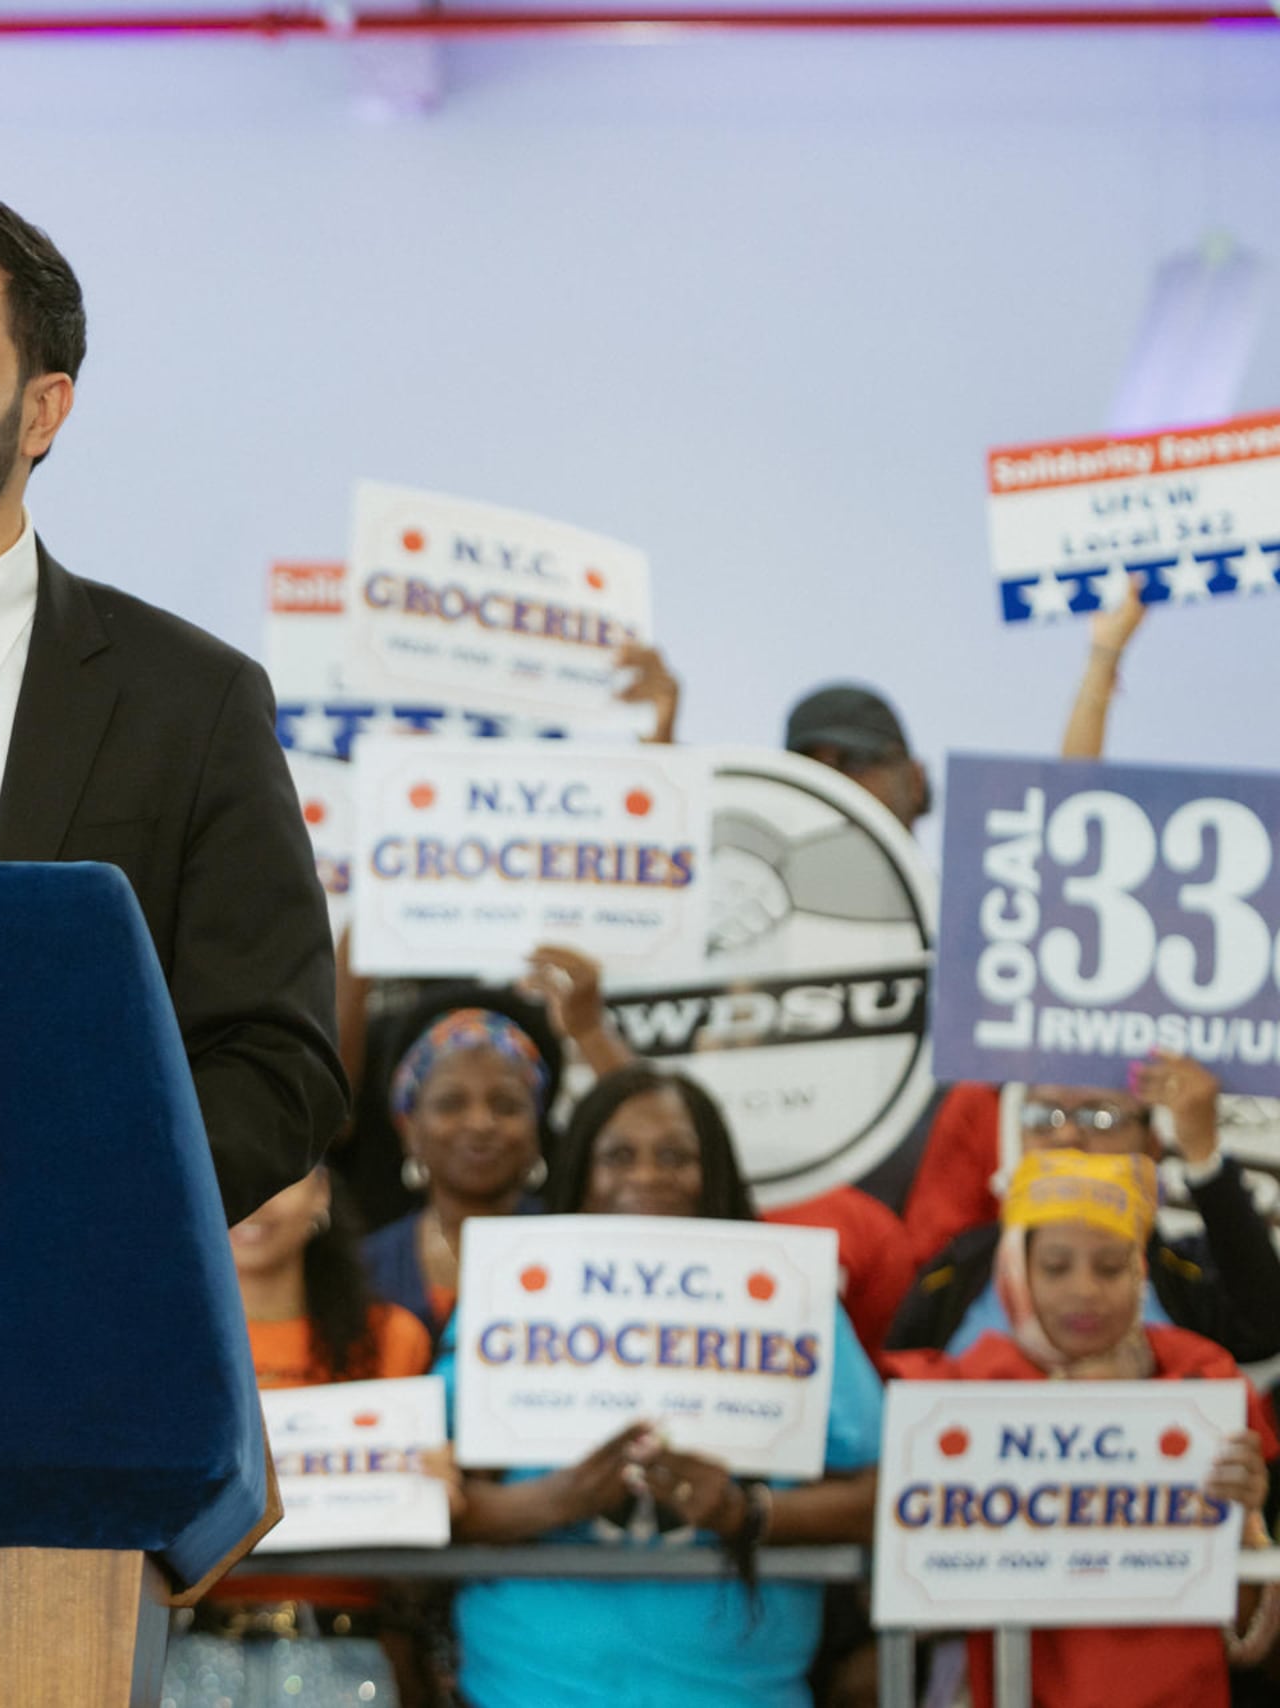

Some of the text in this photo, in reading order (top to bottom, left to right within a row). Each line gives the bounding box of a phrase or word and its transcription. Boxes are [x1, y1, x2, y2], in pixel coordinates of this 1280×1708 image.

[468, 780, 604, 818] N.Y.C.
[371, 836, 694, 889] GROCERIES
[976, 787, 1046, 1050] LOCAL
[1040, 790, 1280, 1014] 33
[1039, 1007, 1280, 1064] RWDSU/U
[582, 1261, 723, 1300] N.Y.C.
[477, 1320, 820, 1379] GROCERIES
[998, 1426, 1137, 1462] N.Y.C.
[895, 1484, 1233, 1530] GROCERIES
